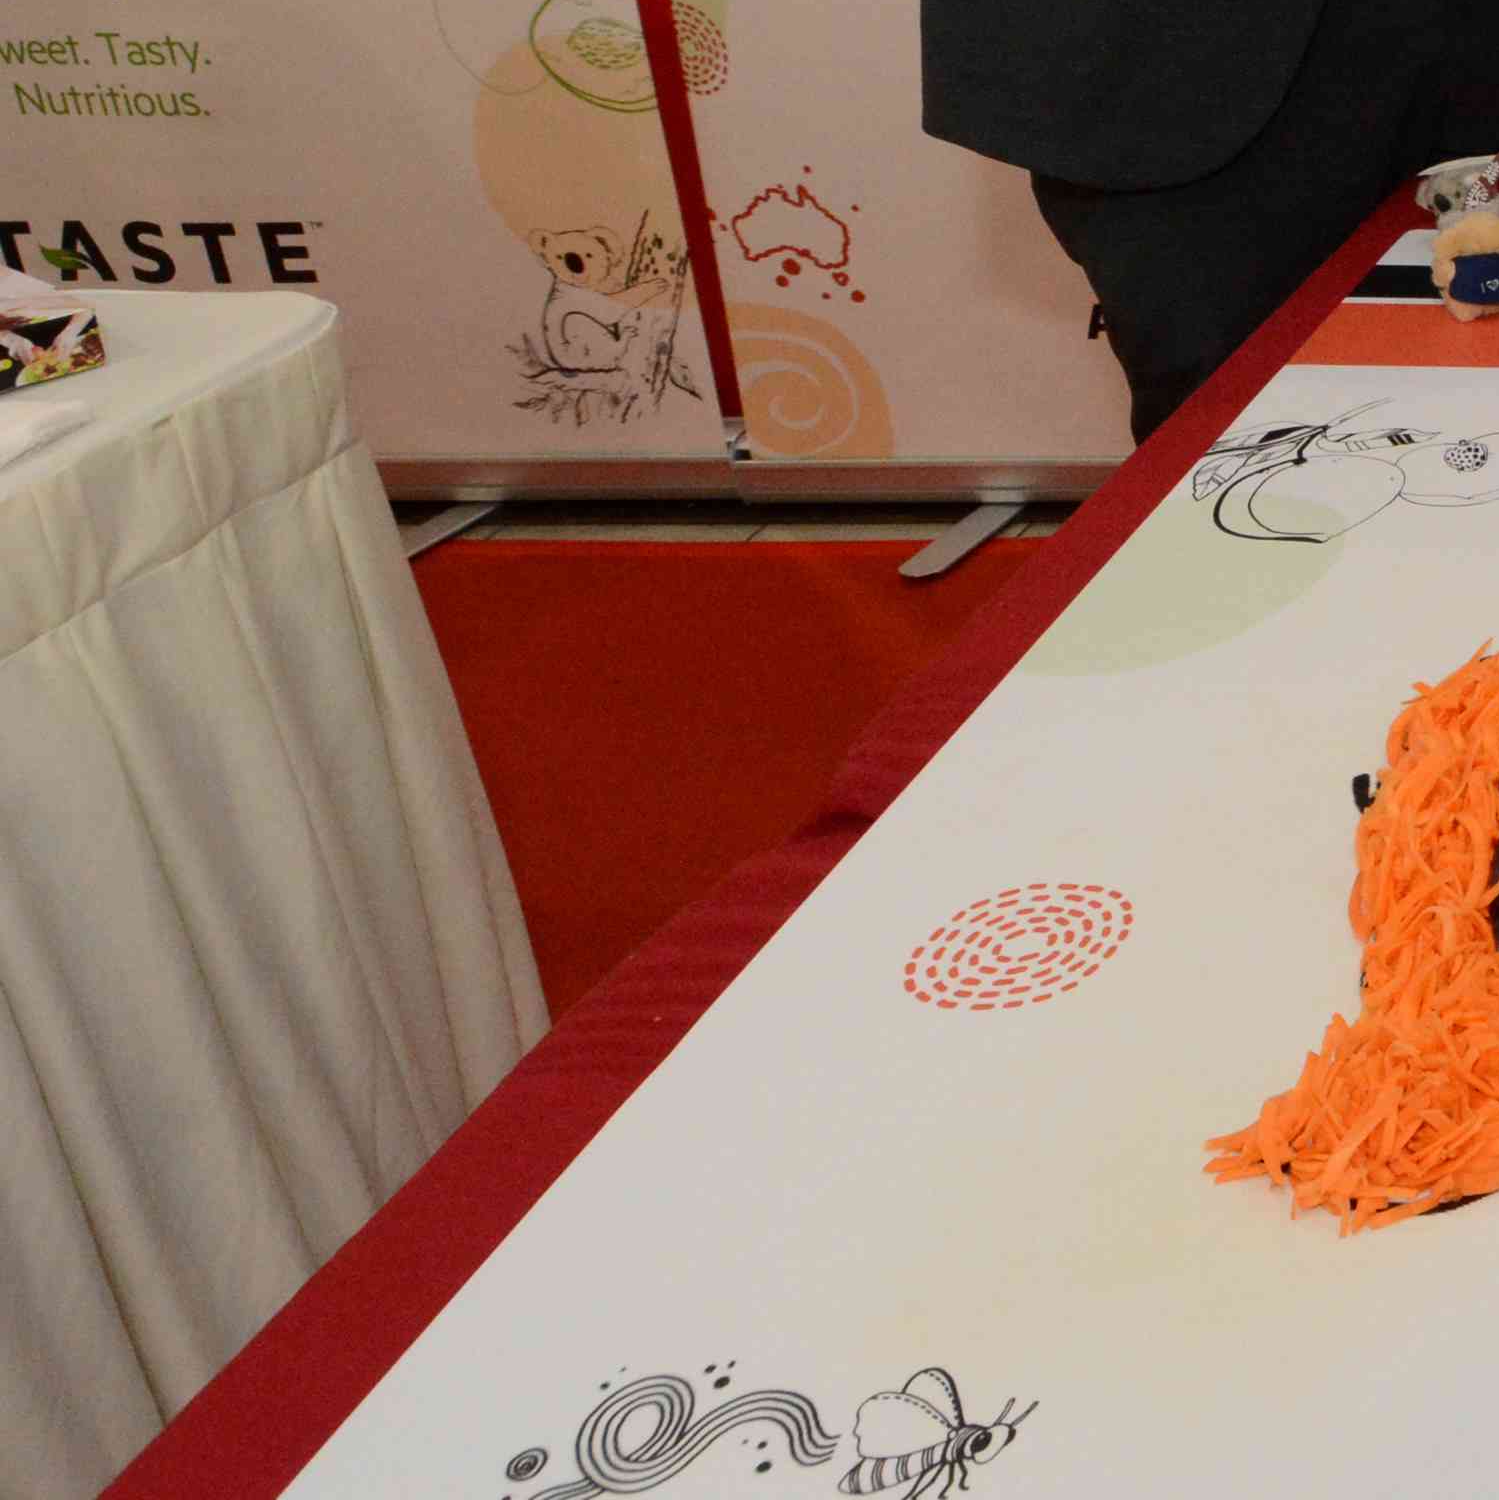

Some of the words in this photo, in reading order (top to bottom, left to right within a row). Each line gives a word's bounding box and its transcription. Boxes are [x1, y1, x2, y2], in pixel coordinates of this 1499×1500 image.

[95, 32, 212, 73] Tasty.
[14, 83, 211, 118] Nutritious.
[0, 220, 319, 285] TASTE
